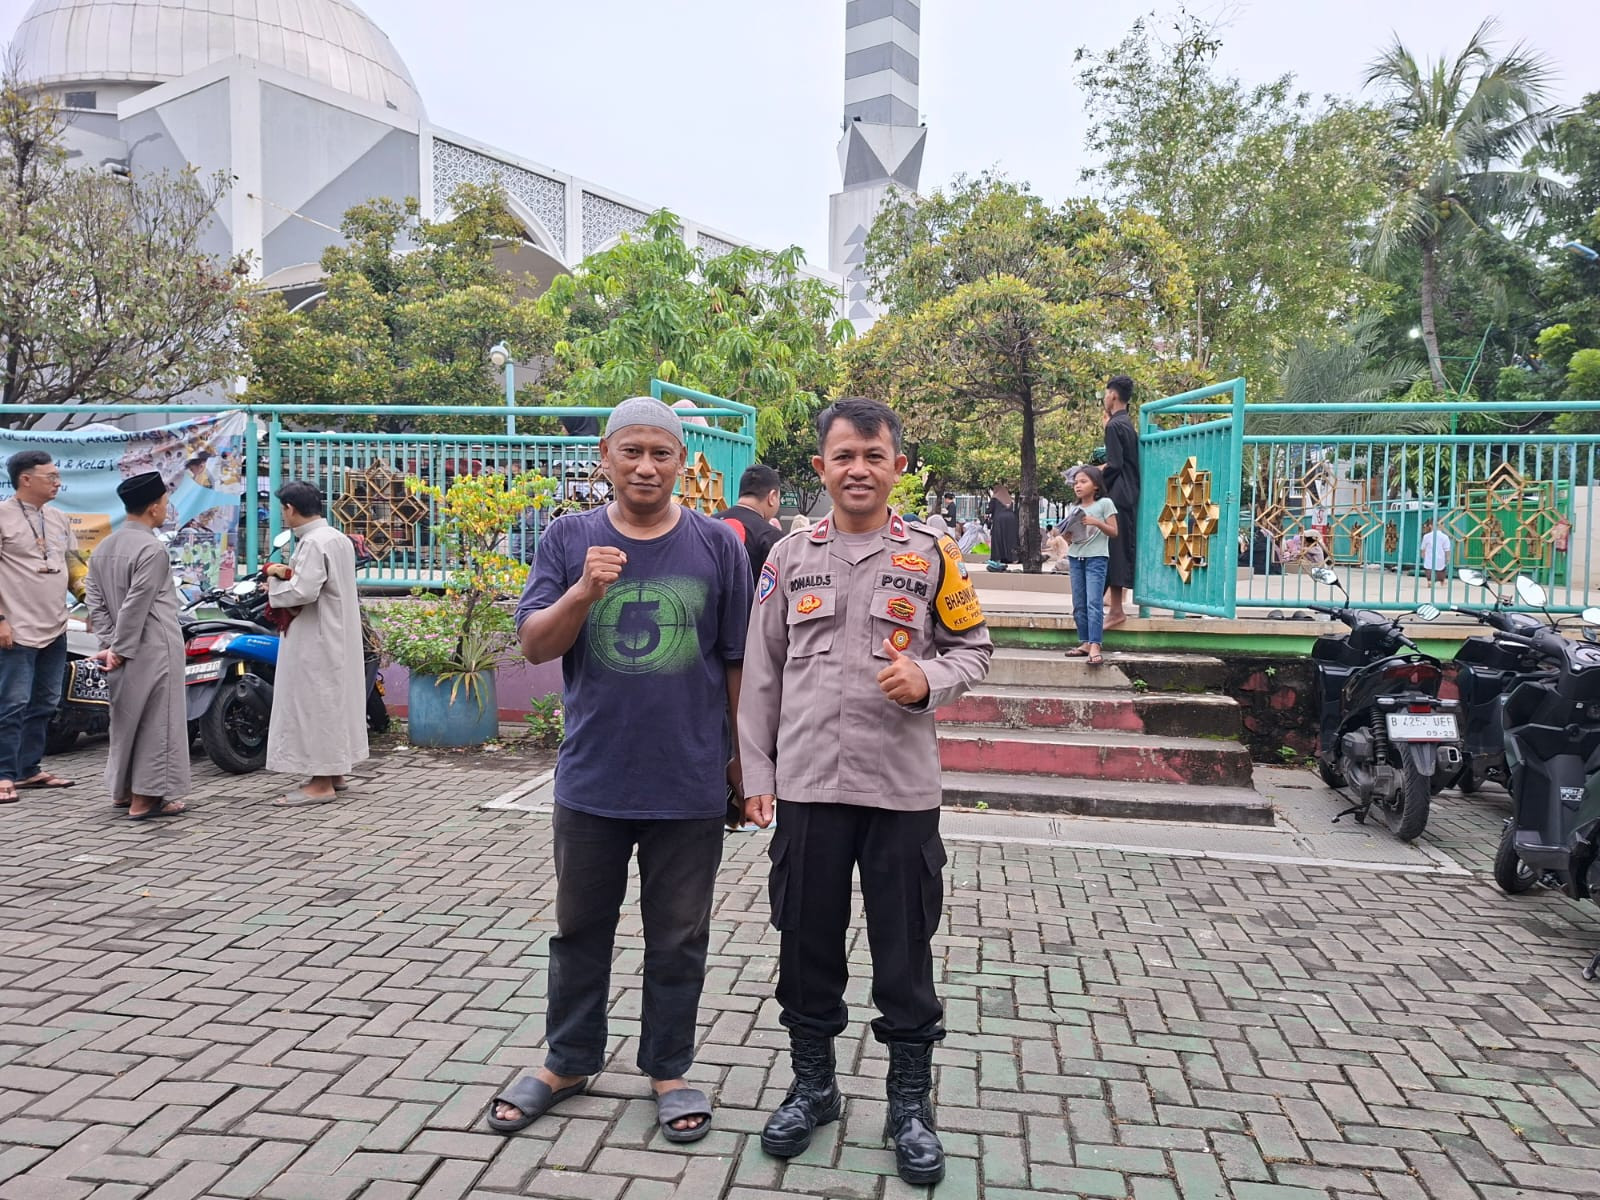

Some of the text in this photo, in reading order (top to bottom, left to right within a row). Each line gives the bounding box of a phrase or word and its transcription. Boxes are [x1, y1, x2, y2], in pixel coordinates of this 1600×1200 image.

[881, 574, 928, 597] POLRI
[614, 600, 660, 657] 5
[1391, 717, 1398, 727] B
